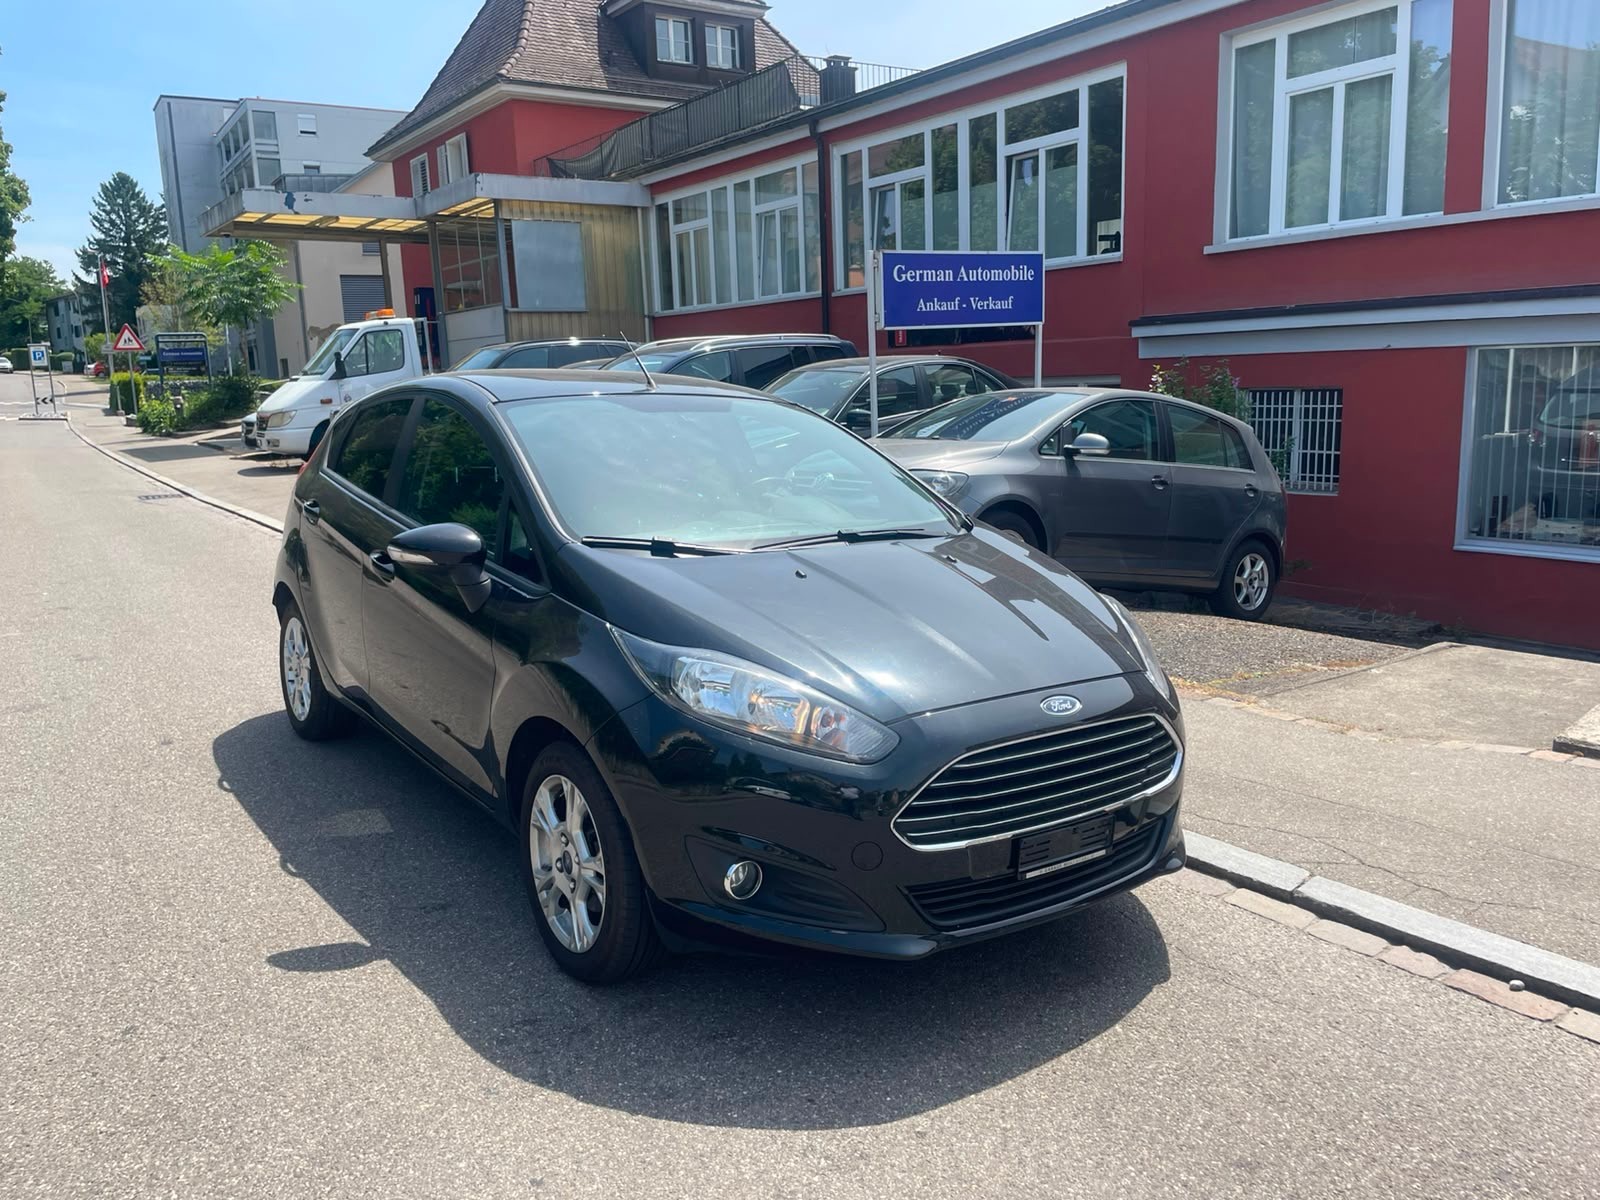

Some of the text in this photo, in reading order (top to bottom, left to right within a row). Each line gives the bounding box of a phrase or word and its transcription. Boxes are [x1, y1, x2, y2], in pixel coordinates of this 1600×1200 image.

[893, 264, 1035, 283] German Automobile
[916, 297, 960, 312] Ankauf
[970, 296, 1014, 310] Verkauf
[35, 351, 42, 361] P
[1050, 699, 1073, 712] Ford
